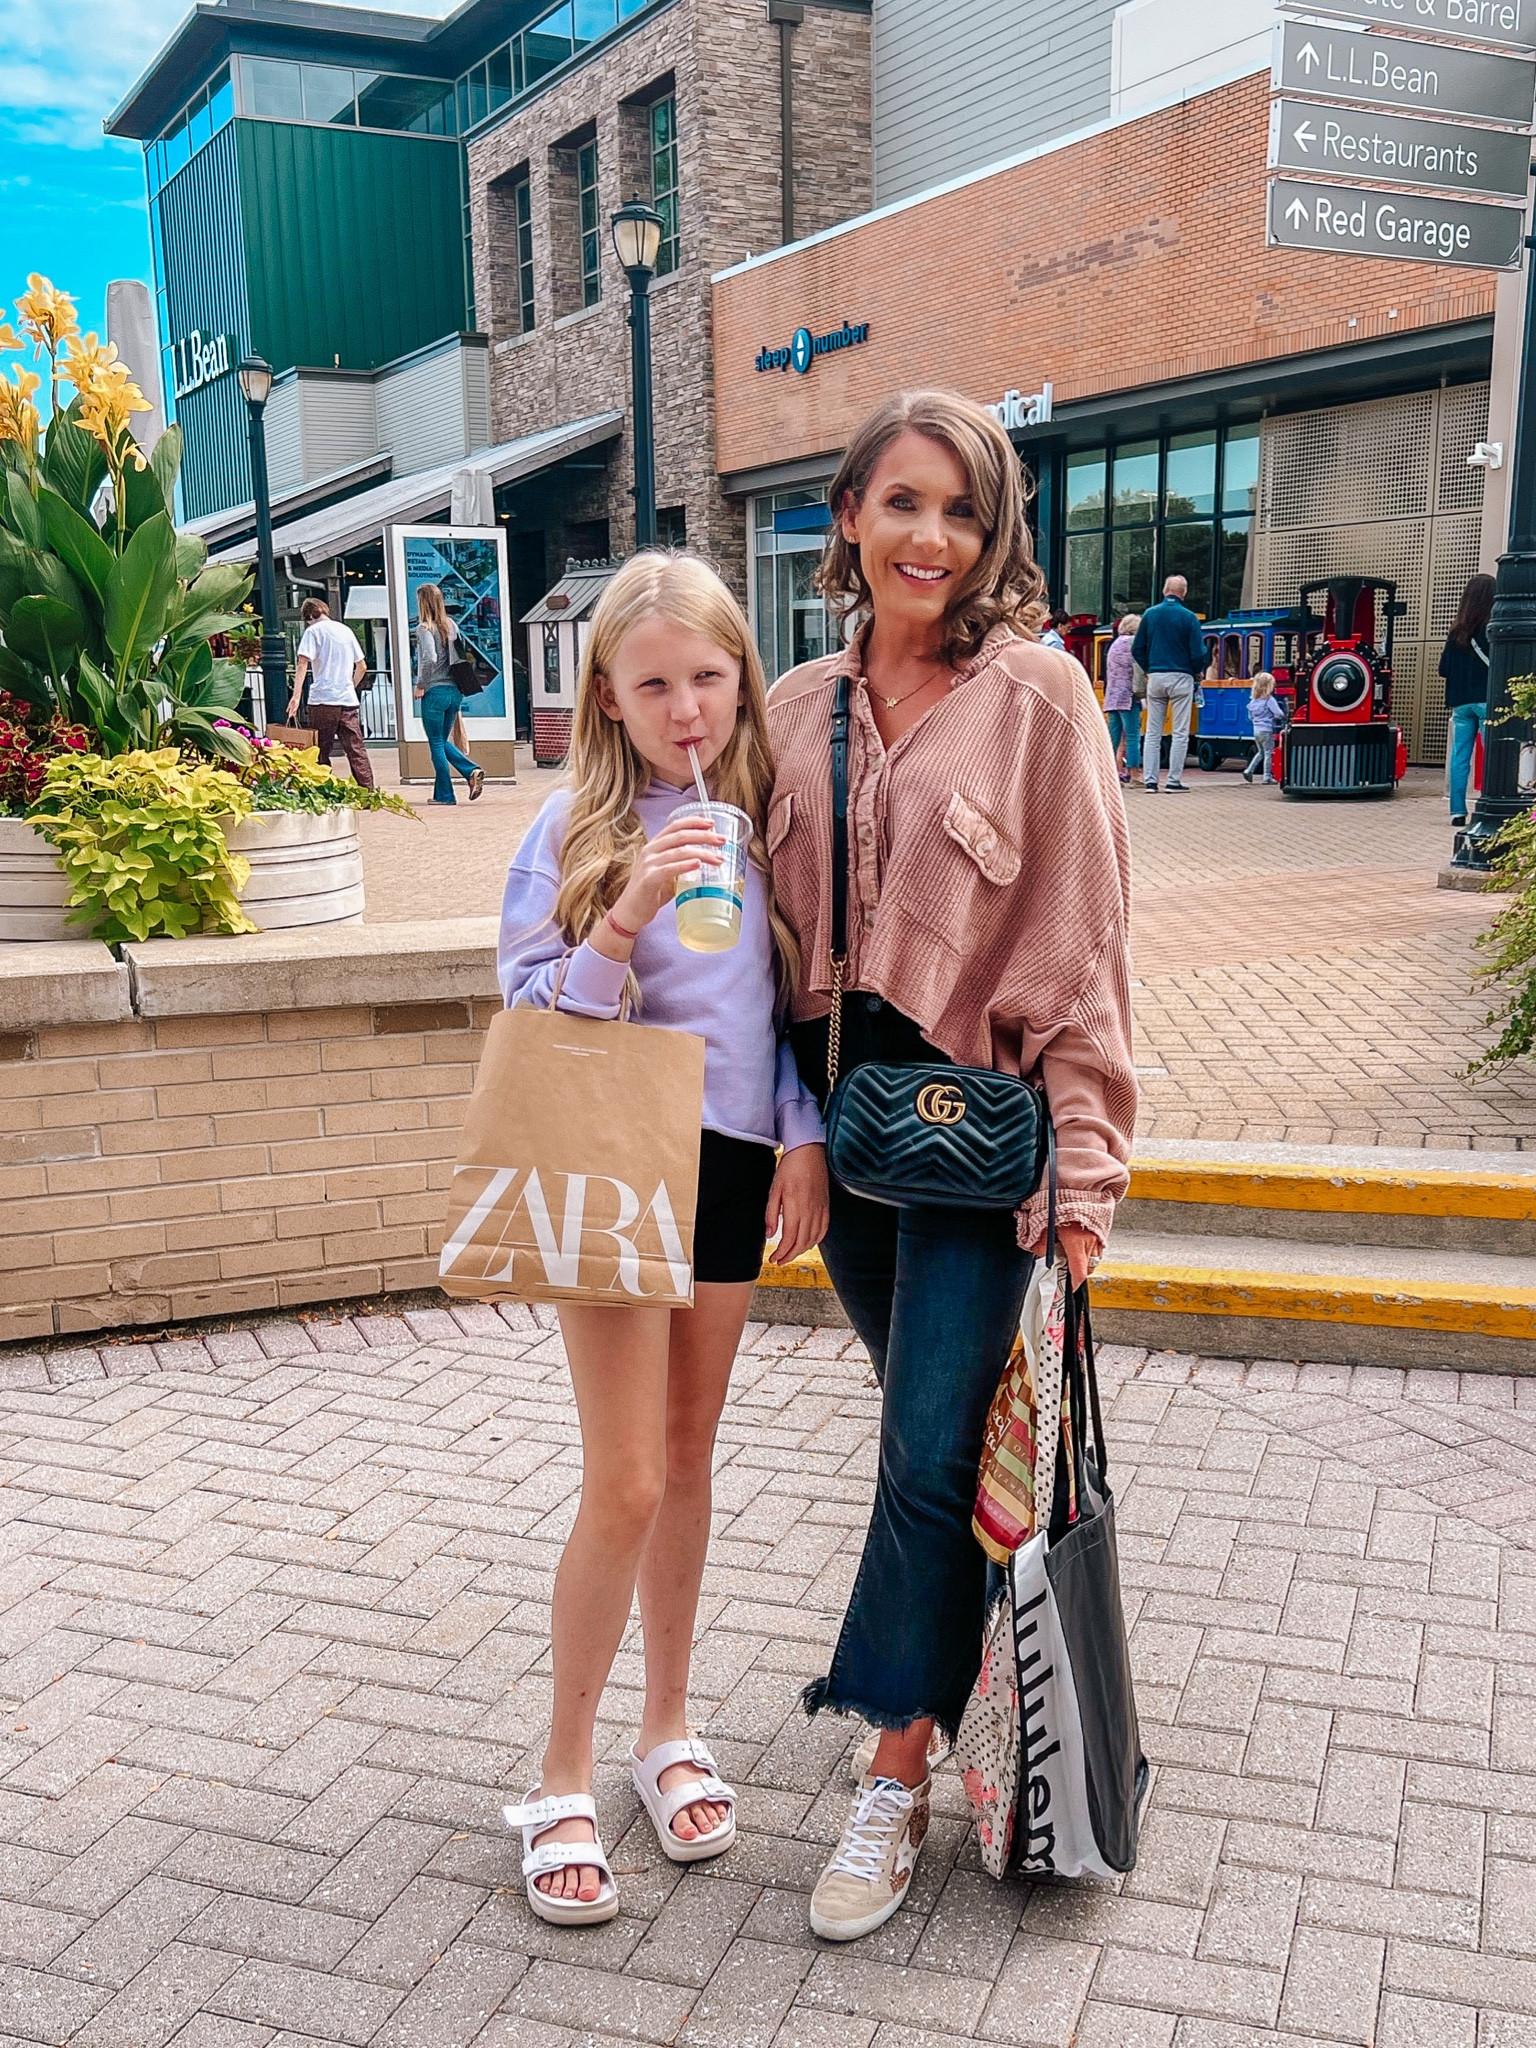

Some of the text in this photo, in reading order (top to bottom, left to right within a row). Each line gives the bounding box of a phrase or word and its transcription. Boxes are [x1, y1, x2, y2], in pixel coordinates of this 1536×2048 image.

[1446, 0, 1521, 31] Barrel
[1326, 43, 1439, 96] L.L.Bean
[1322, 121, 1479, 176] Restaurants
[1315, 197, 1471, 257] Red Garage
[171, 329, 230, 400] L.L.Bean
[755, 320, 870, 372] sleep number
[438, 1165, 694, 1298] ZARA
